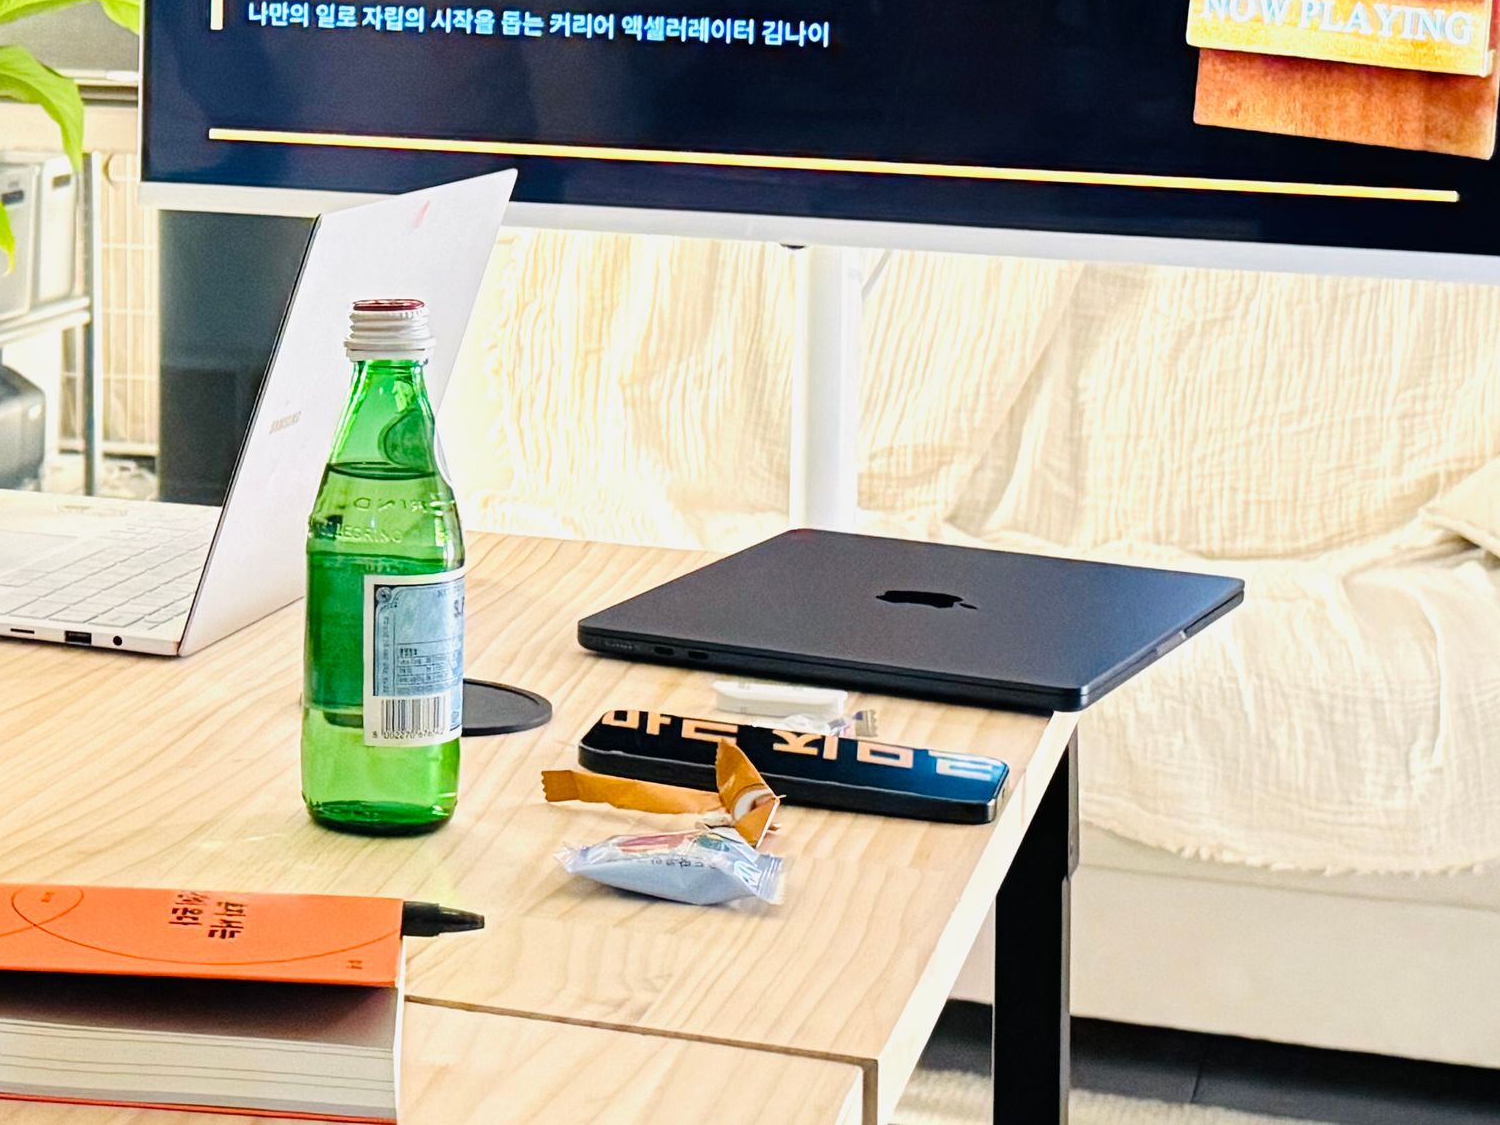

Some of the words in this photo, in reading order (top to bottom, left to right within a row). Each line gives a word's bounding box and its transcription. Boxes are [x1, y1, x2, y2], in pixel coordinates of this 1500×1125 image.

[248, 1, 309, 27] 나만의
[315, 3, 357, 28] 일로
[362, 4, 425, 33] 자립의
[431, 7, 496, 35] 시작을
[501, 10, 545, 37] 돕는
[550, 12, 614, 40] 커리어
[762, 20, 830, 48] 김나이
